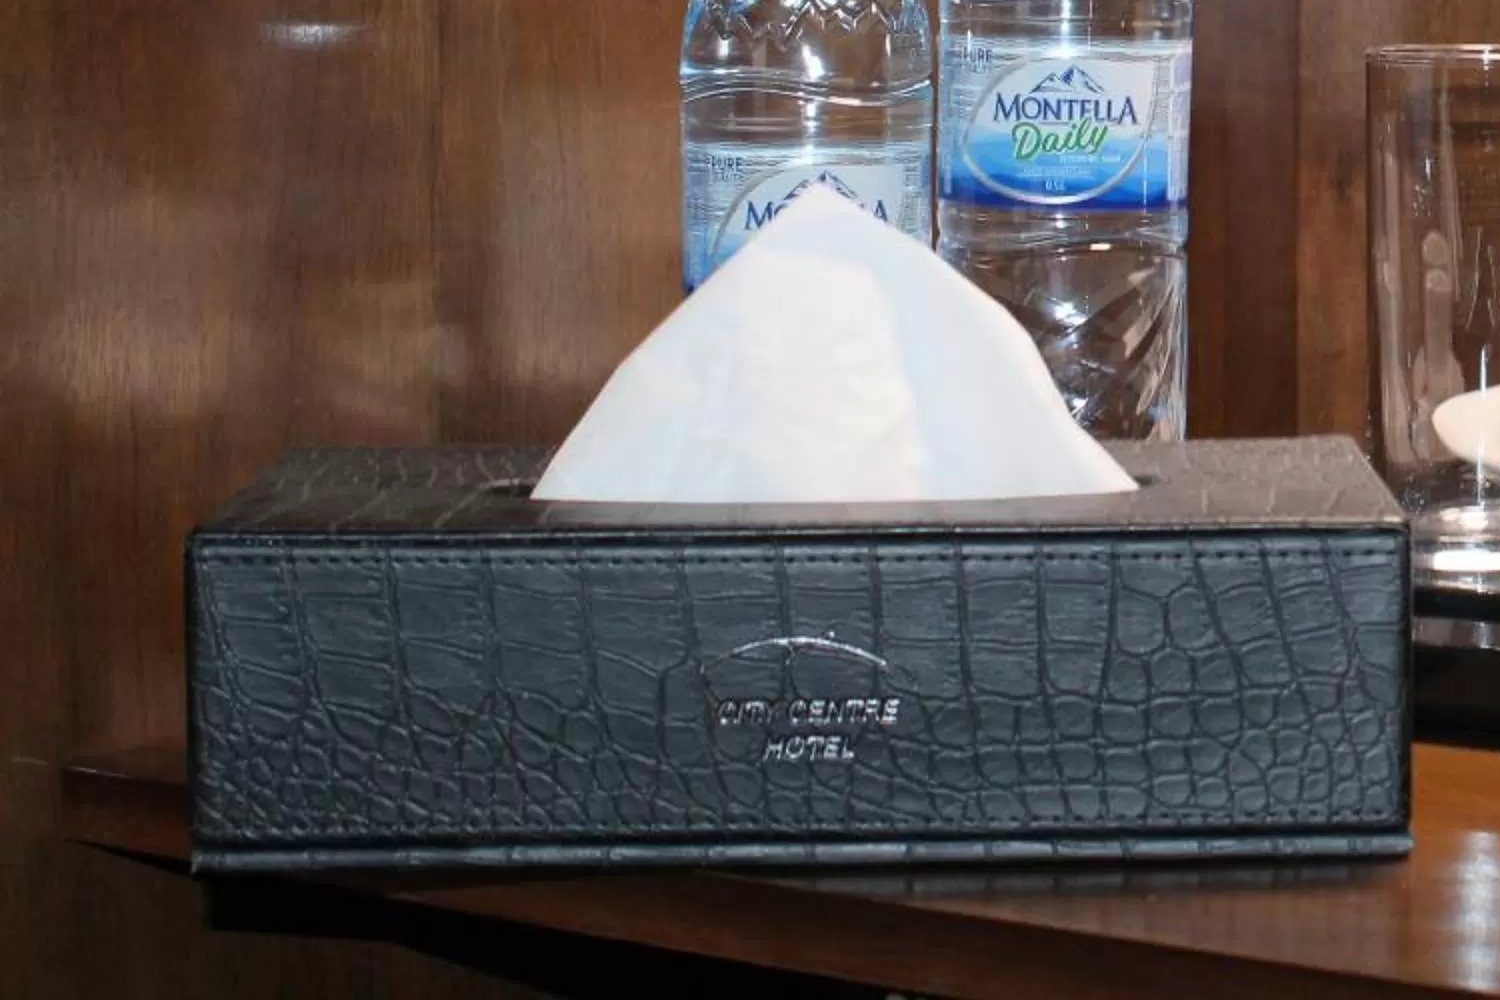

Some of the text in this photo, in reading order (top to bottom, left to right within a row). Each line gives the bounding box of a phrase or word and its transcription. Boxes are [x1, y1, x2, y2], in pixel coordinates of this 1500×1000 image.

[993, 92, 1138, 125] MONTELLA
[1011, 116, 1109, 161] Daily
[717, 698, 900, 725] CITY CENTRE
[763, 734, 855, 761] HOTEL
